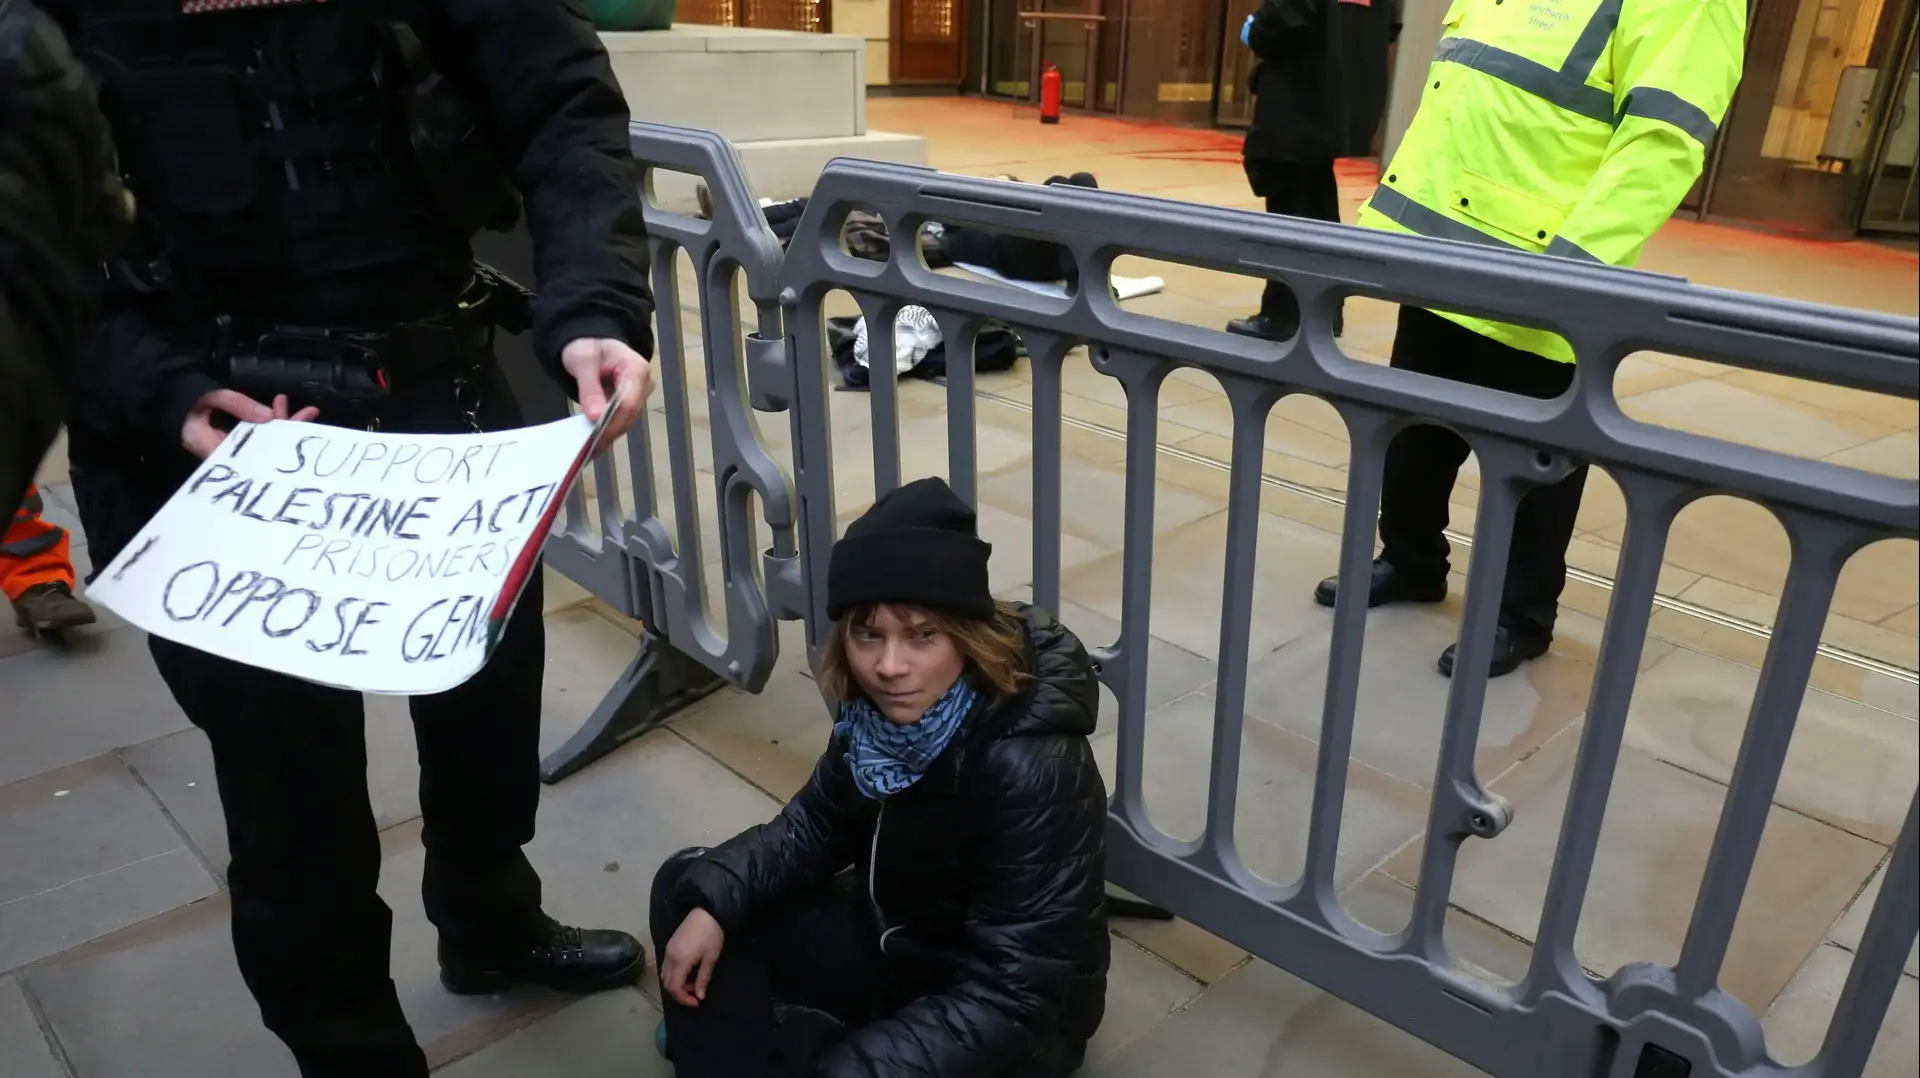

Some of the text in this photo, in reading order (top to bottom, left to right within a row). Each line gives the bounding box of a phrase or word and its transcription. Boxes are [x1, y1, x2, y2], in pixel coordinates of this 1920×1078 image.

[231, 427, 518, 484] I SUPPORT
[189, 463, 557, 540] PALESTINE ACTI
[282, 536, 519, 581] PRISONERS
[113, 534, 159, 580] I
[162, 560, 391, 655] OPPOSE
